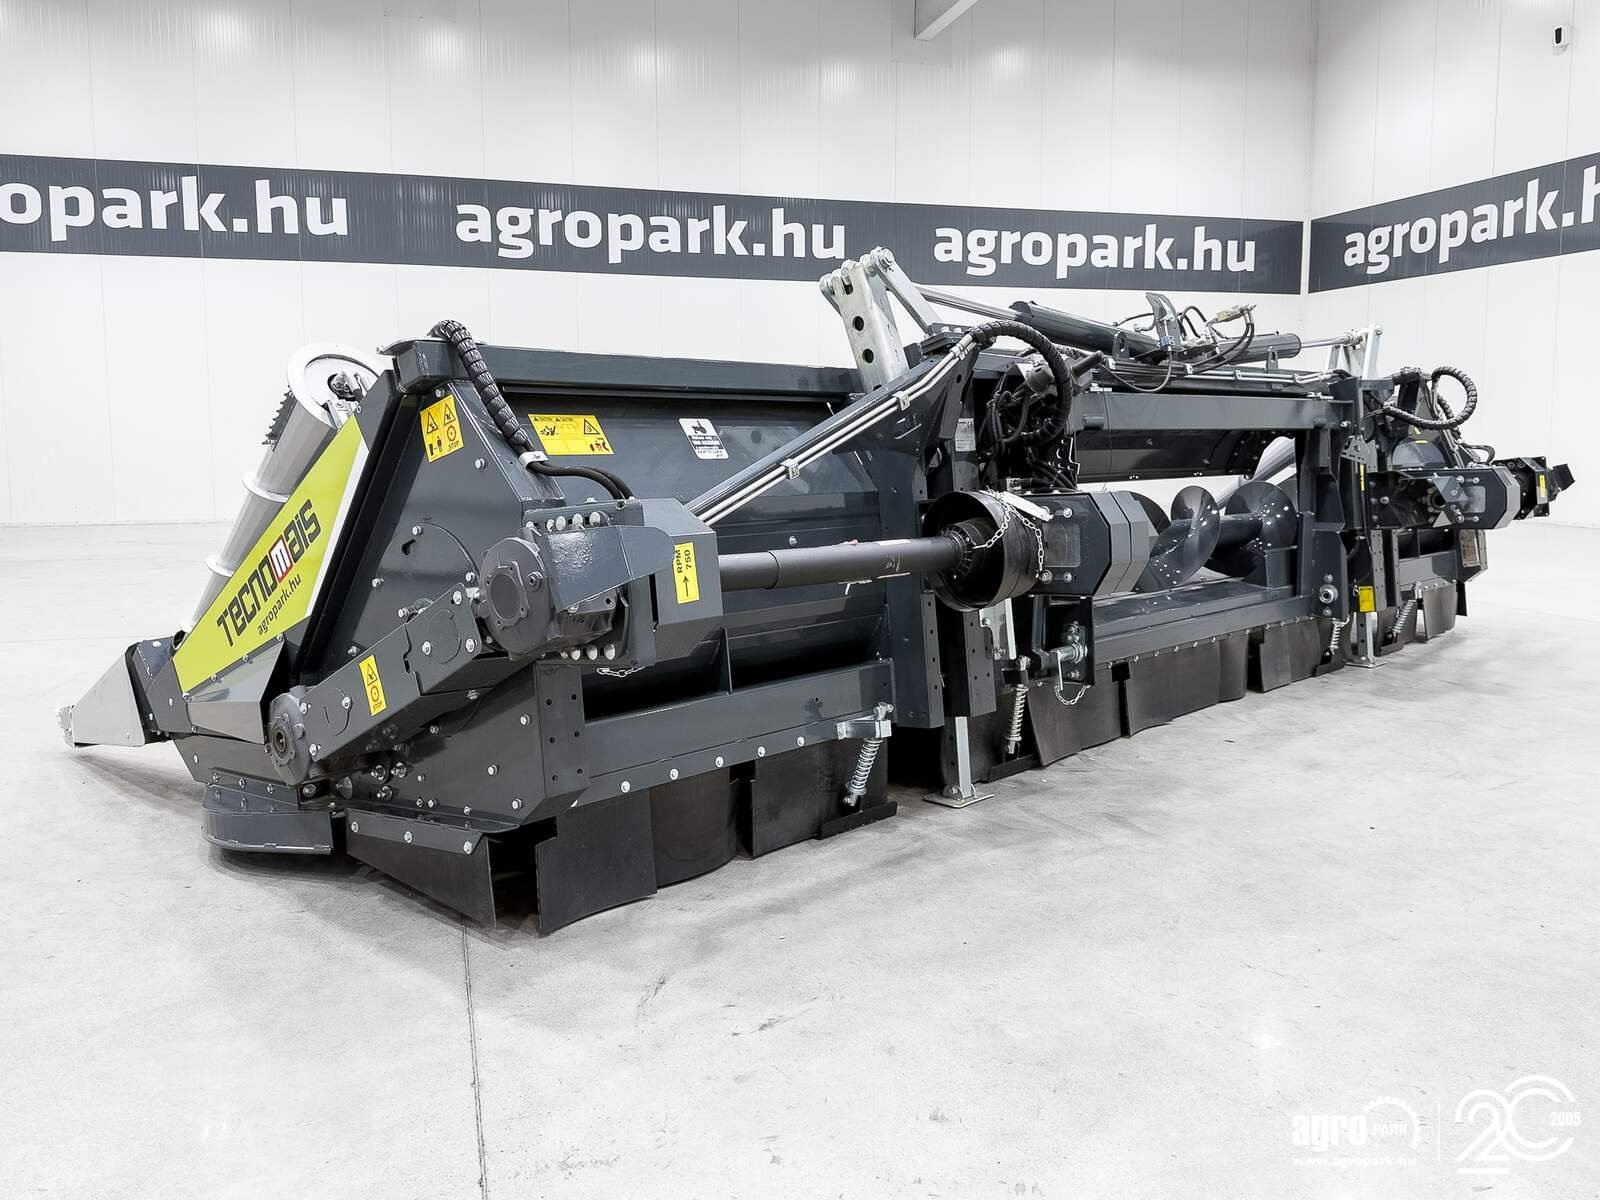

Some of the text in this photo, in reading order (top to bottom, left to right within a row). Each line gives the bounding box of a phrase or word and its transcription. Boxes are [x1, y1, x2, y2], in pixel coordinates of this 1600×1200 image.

[455, 203, 845, 264] agropark.hu
[933, 223, 1256, 279] agropark.hu
[675, 549, 683, 573] RPM
[683, 549, 692, 570] 750
[257, 574, 302, 636] agropark.hu
